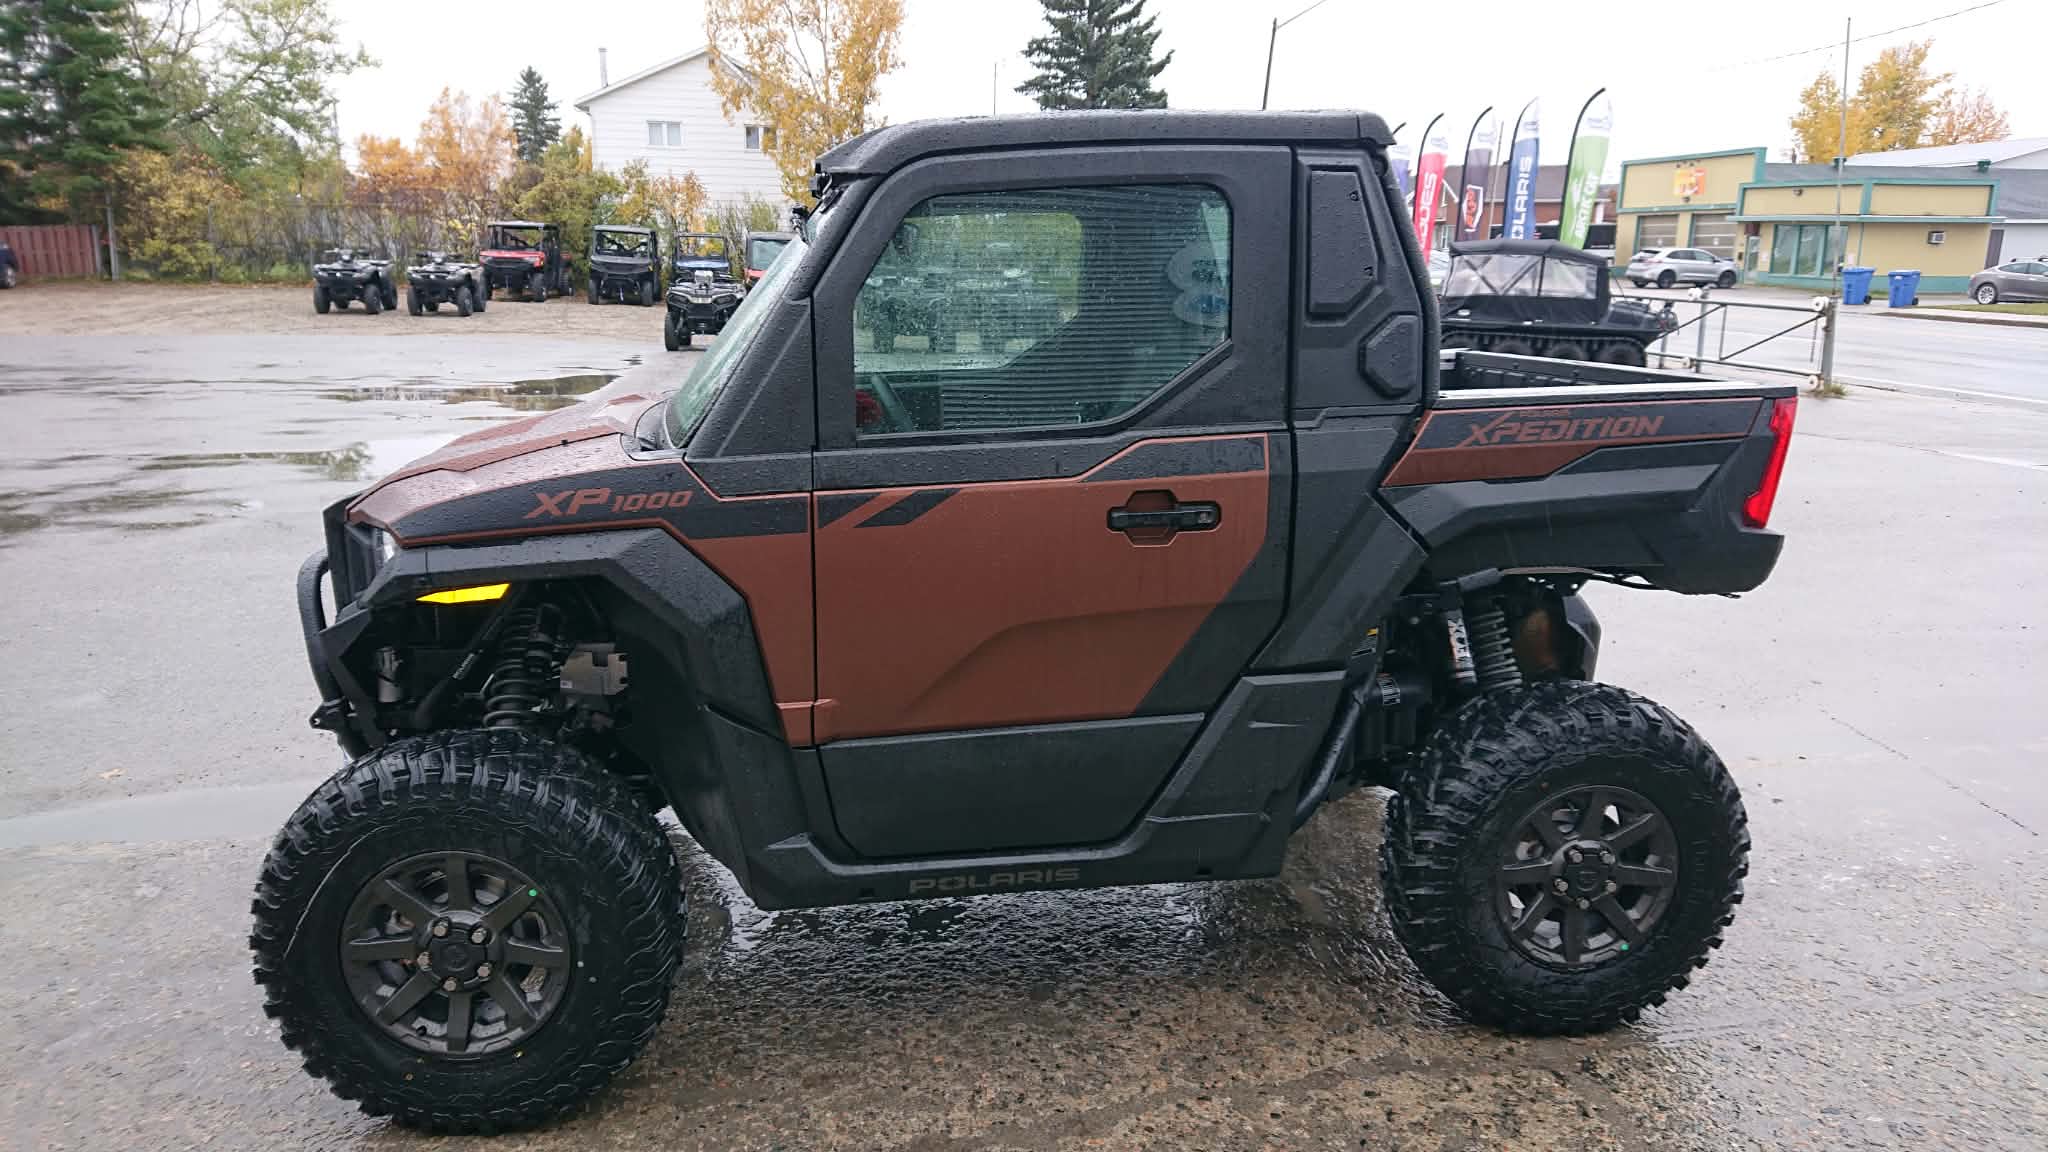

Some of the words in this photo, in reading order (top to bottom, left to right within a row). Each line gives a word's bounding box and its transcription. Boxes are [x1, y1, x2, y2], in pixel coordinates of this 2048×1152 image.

[1511, 156, 1533, 240] OLARIS
[1456, 410, 1665, 449] XPEDITION
[522, 487, 613, 519] XP
[610, 490, 694, 513] 1000
[909, 867, 1081, 894] POLARIS
